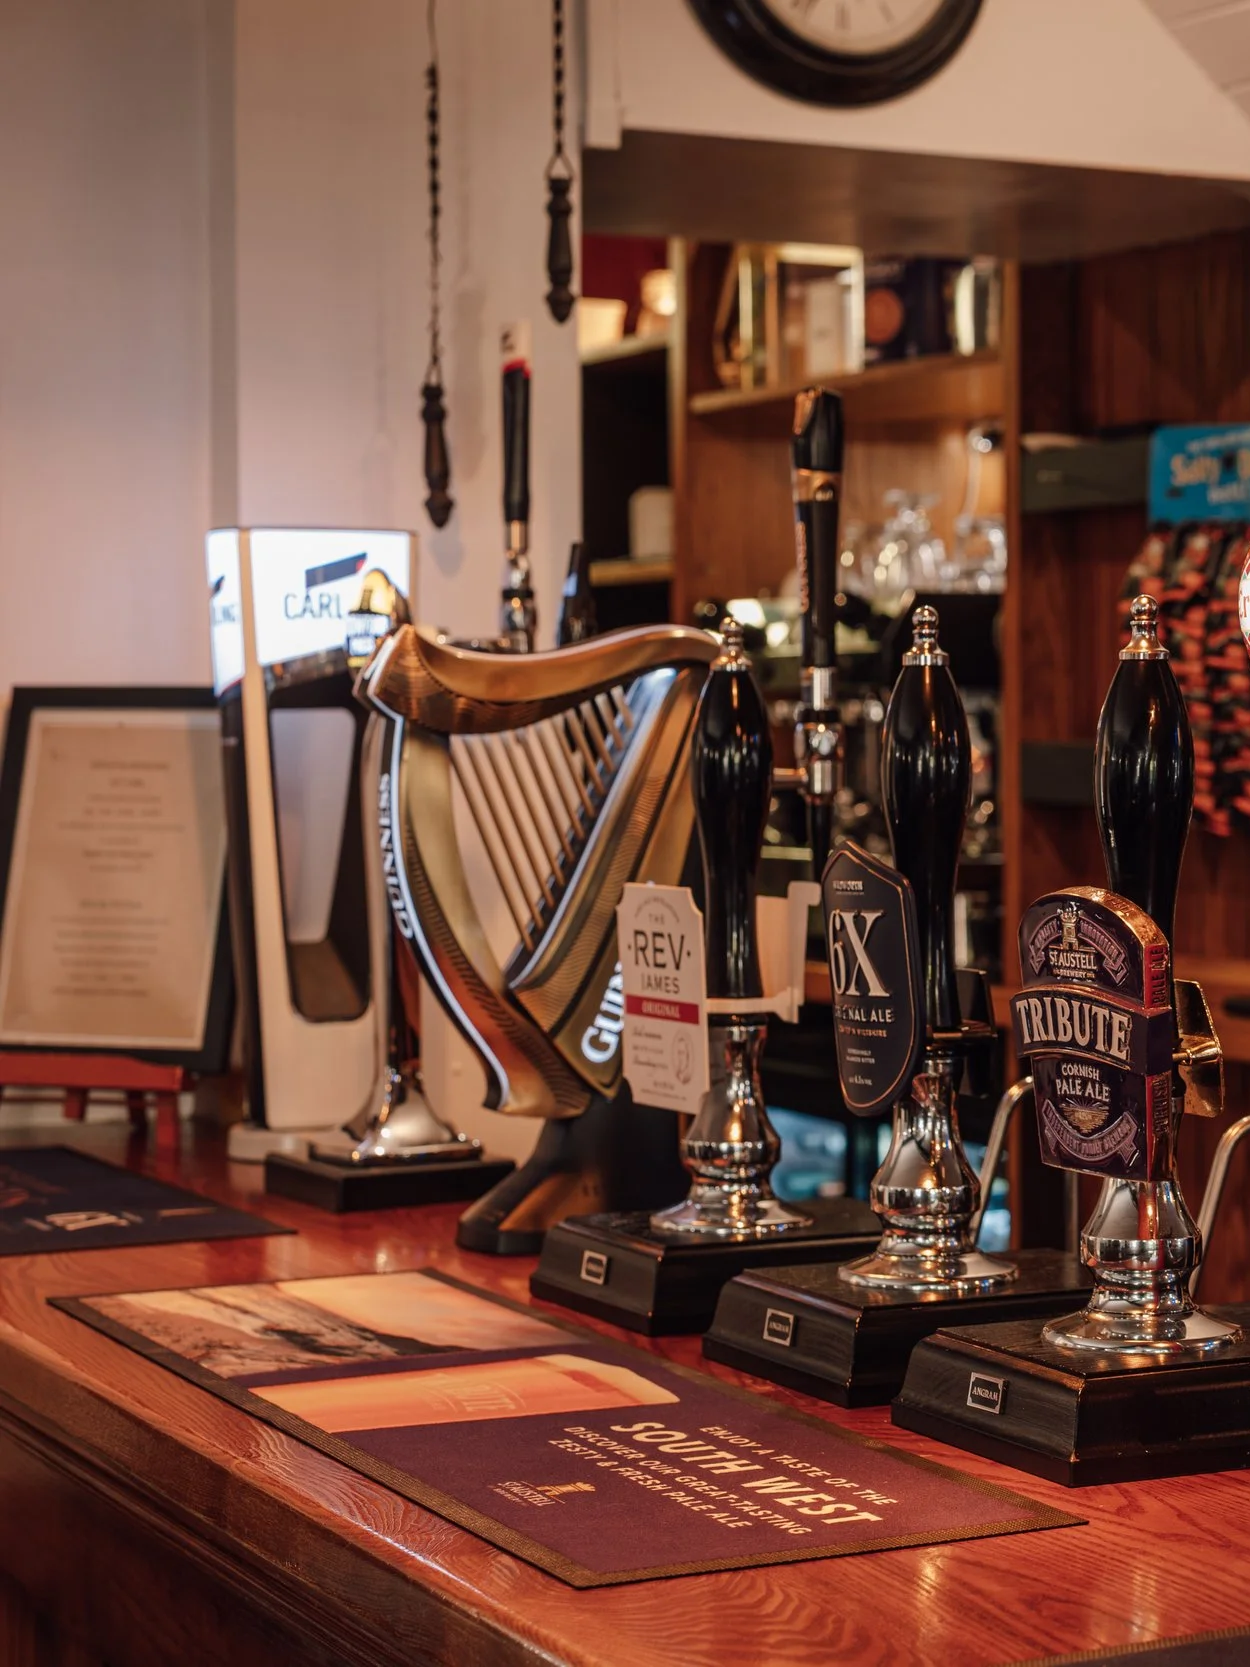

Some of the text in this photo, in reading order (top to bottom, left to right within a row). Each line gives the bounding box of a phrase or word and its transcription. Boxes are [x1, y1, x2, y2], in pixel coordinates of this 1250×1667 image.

[634, 929, 684, 971] REV
[829, 909, 891, 997] 6X
[1058, 952, 1097, 970] AUSTELL
[870, 1008, 892, 1023] ALE
[1016, 998, 1132, 1061] TRIBUTE
[1055, 1079, 1110, 1102] PALE ALE
[1061, 1062, 1099, 1081] CORNISH
[548, 1438, 608, 1460] ZESTY
[610, 1467, 674, 1492] FRESH
[661, 1491, 717, 1512] PALE
[706, 1512, 753, 1529] ALE
[563, 1426, 813, 1535] DISCOVER OUR GREAT-TASTING
[610, 1422, 884, 1525] SOUTH WEST
[700, 1425, 762, 1448] ENJOY
[770, 1454, 831, 1478] TASTE
[824, 1477, 860, 1489] OF
[853, 1489, 899, 1505] THE
